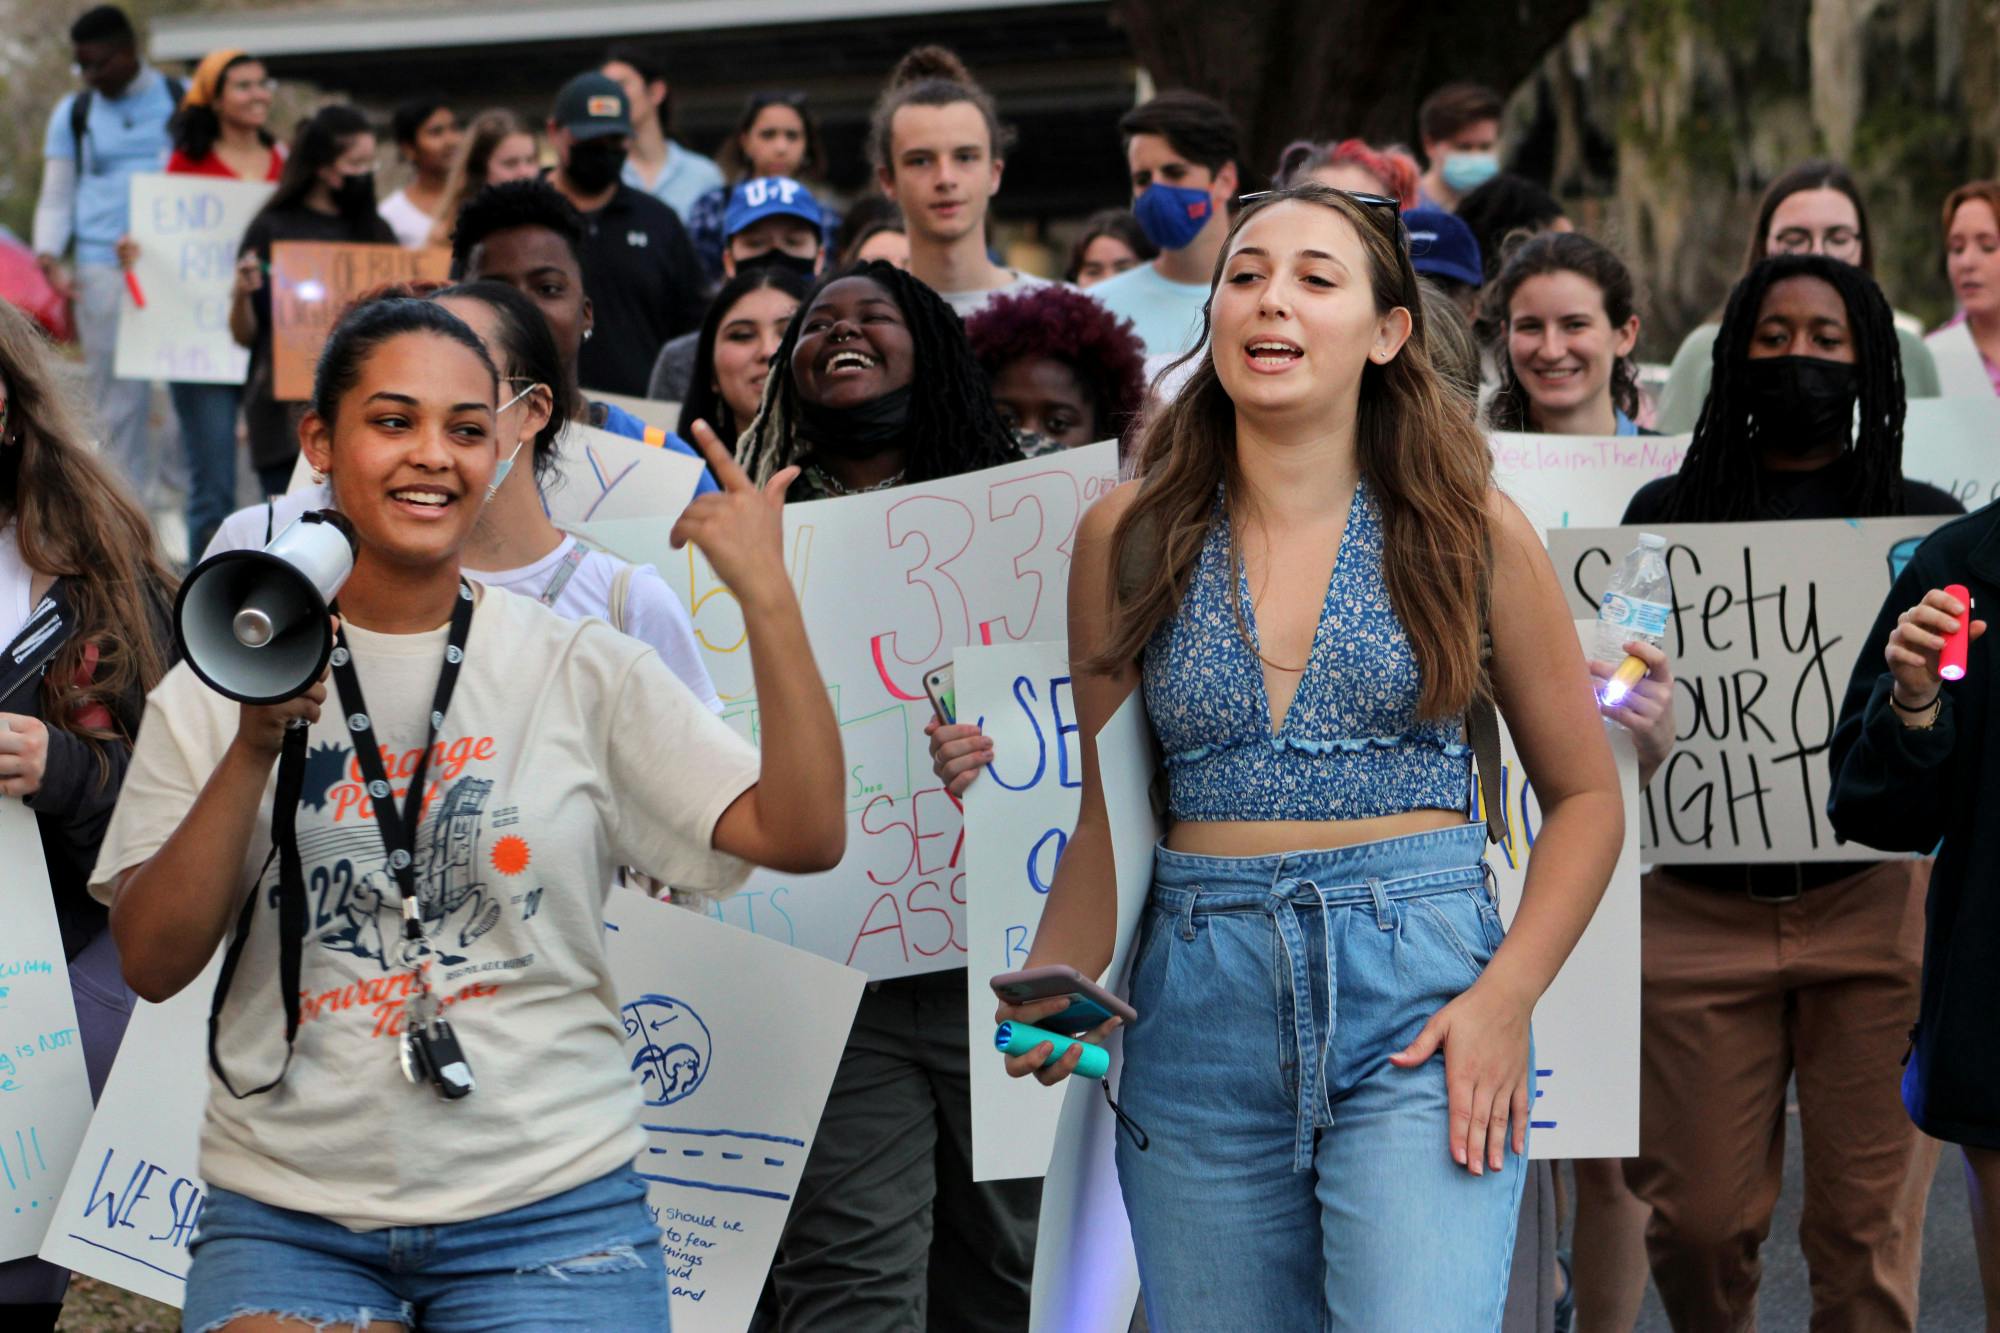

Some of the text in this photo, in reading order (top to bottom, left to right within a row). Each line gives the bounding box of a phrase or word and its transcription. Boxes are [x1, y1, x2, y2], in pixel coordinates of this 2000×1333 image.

[1573, 544, 1843, 752] Sfety
[38, 1028, 77, 1052] NOT
[84, 1147, 168, 1228] WE
[665, 1208, 717, 1228] should
[665, 1227, 717, 1248] to fear
[671, 1286, 706, 1302] and
